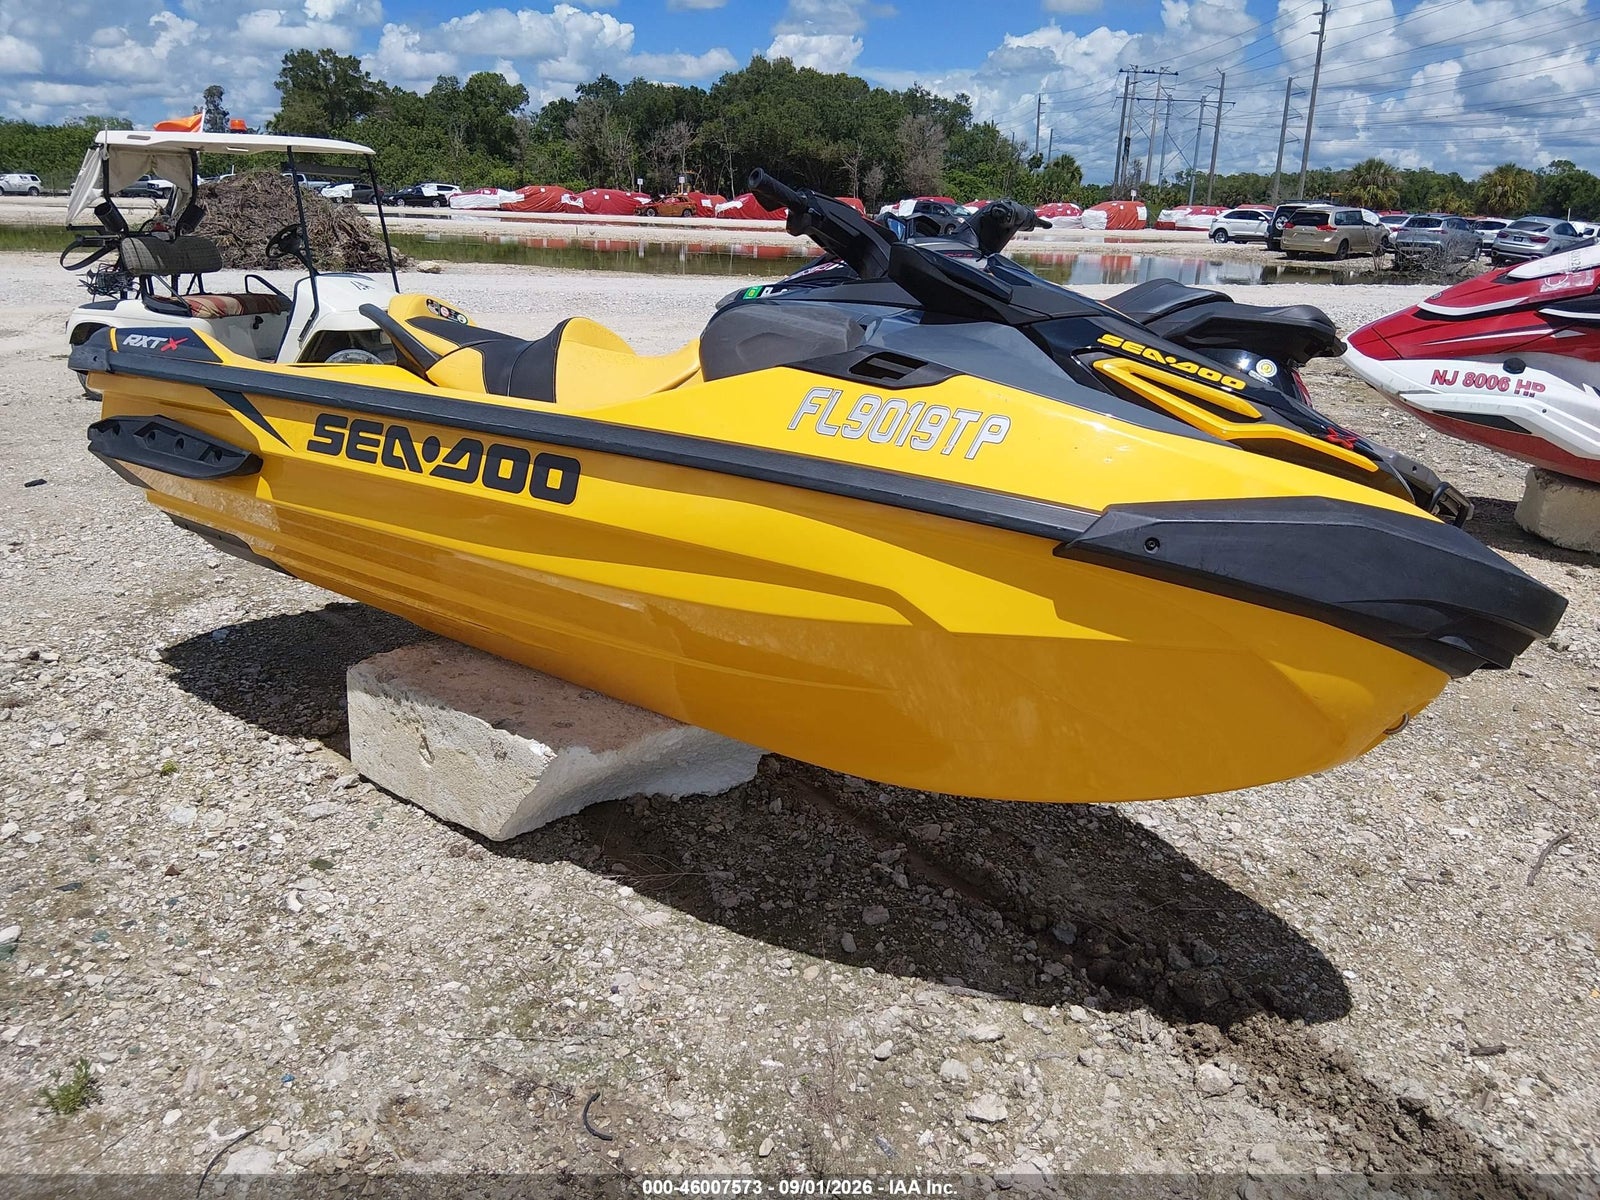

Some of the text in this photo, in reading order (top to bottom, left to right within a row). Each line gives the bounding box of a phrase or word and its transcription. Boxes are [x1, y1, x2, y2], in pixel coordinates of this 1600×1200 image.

[122, 333, 168, 349] RXT
[1430, 369, 1546, 398] NJ 8006 HP
[787, 386, 1012, 460] FL9019TP
